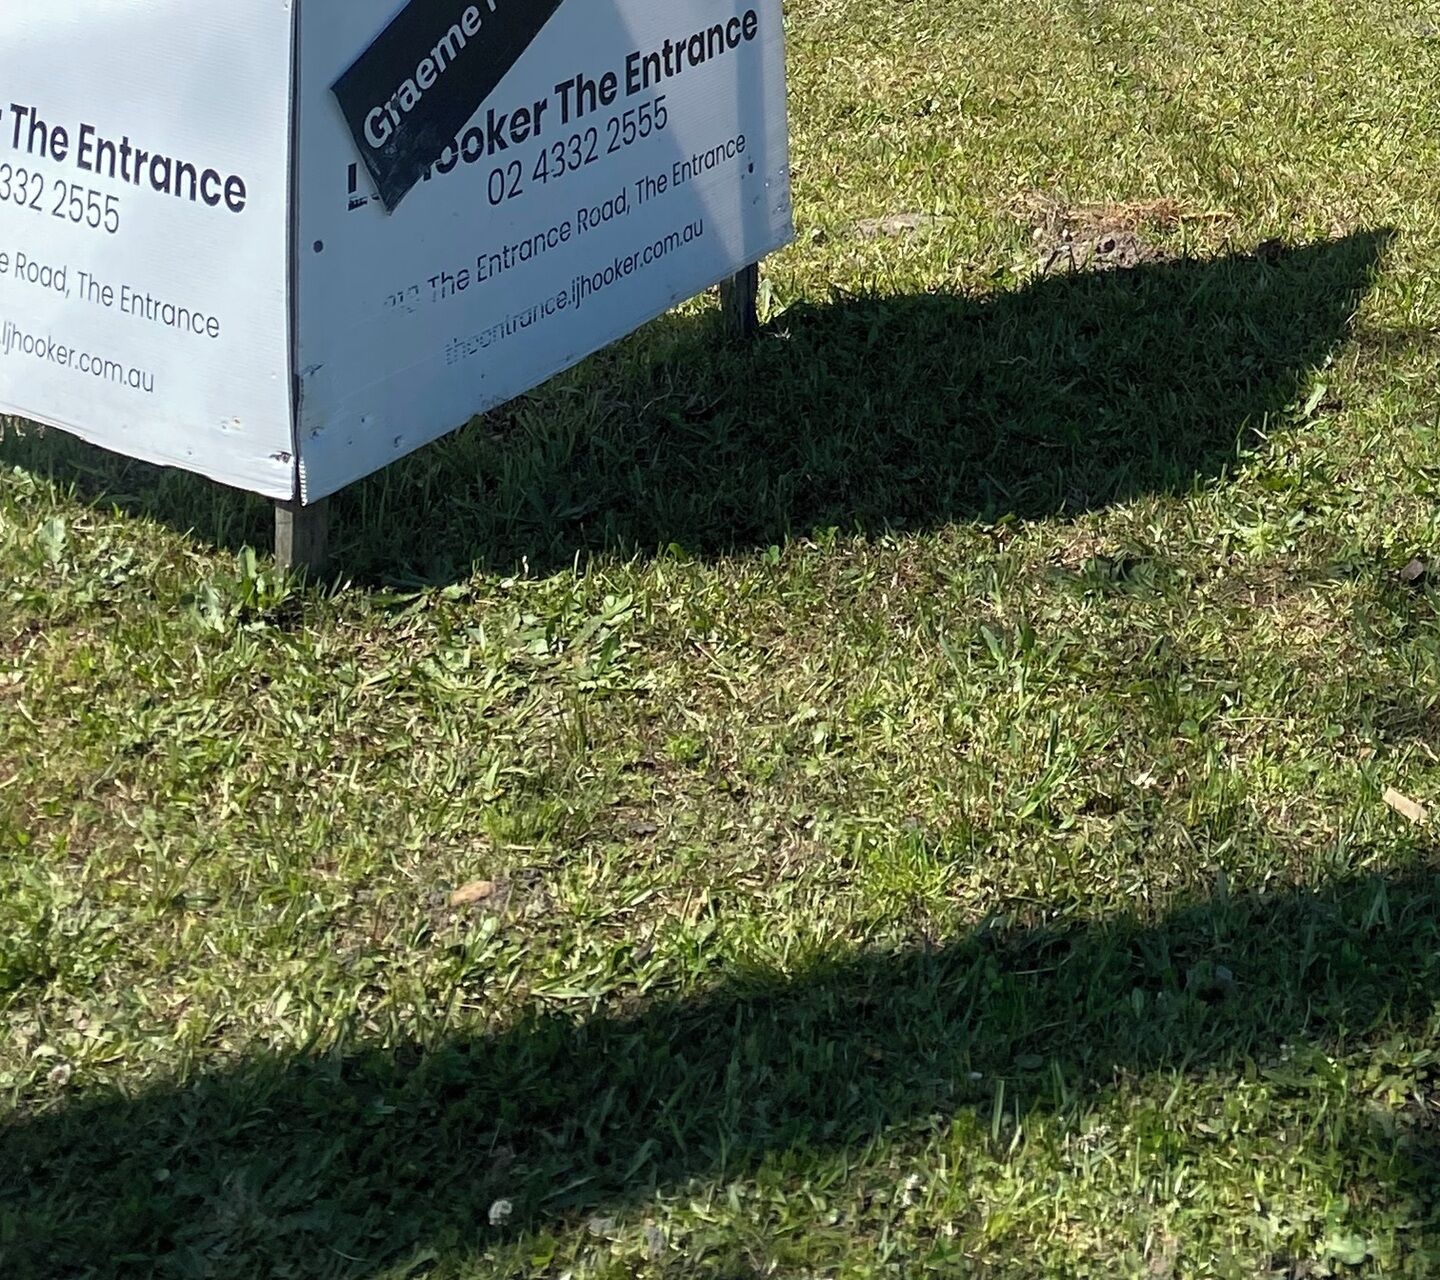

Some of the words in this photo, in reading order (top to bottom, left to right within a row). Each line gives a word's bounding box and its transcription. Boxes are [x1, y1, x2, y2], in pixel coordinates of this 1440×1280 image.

[363, 5, 482, 149] Graeme
[423, 97, 548, 182] ooker
[554, 72, 618, 126] The
[625, 9, 758, 97] Entrance
[10, 103, 69, 162] The
[77, 122, 247, 214] Entrance
[487, 159, 523, 206] 02
[532, 126, 598, 184] 4332
[606, 95, 668, 155] 2555
[51, 179, 120, 234] 2555
[428, 268, 470, 303] The
[477, 220, 571, 283] Entrance
[576, 187, 631, 235] Road,
[635, 174, 668, 205] The
[672, 134, 746, 187] Entrance
[15, 252, 70, 299] Road,
[78, 271, 114, 307] The
[120, 285, 220, 339] Entrance
